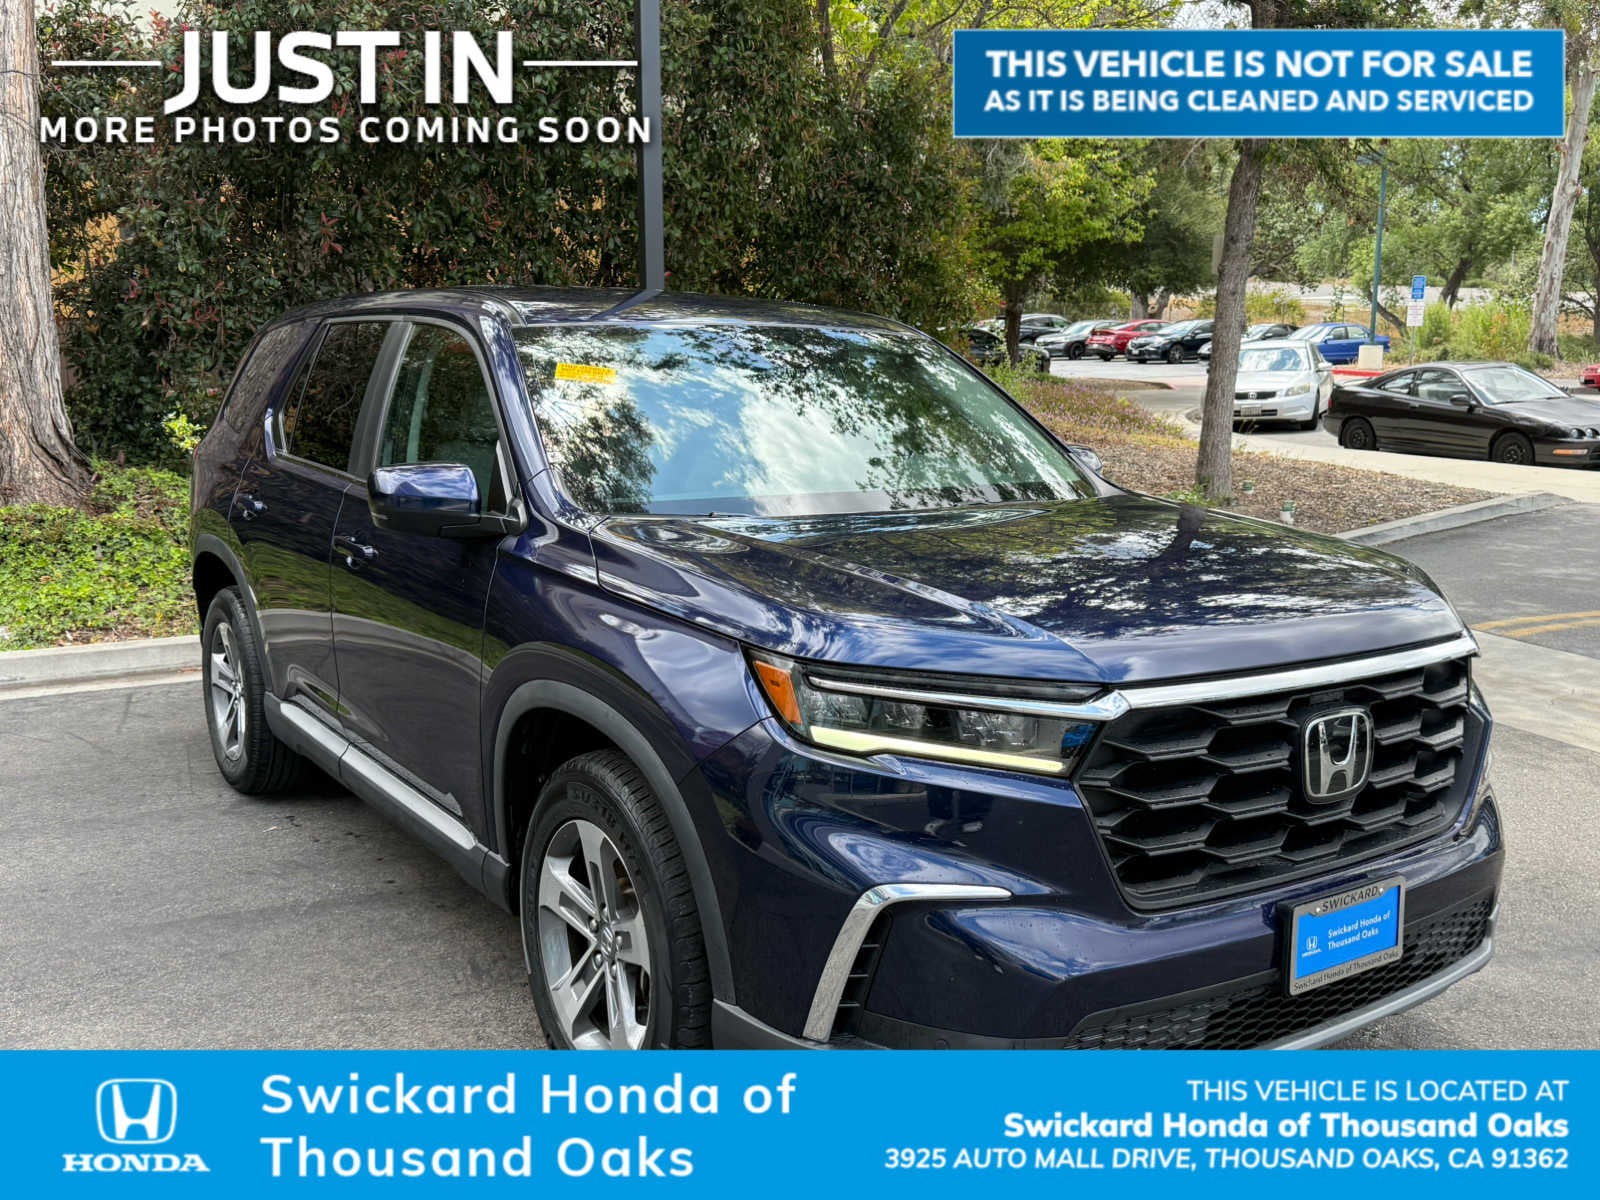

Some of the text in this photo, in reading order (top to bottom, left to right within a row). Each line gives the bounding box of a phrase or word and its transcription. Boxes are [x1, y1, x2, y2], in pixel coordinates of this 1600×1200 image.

[1322, 886, 1378, 912] SWICKARD
[1328, 910, 1391, 938] Swickard Honda of
[1327, 927, 1379, 950] Thousand Oaks
